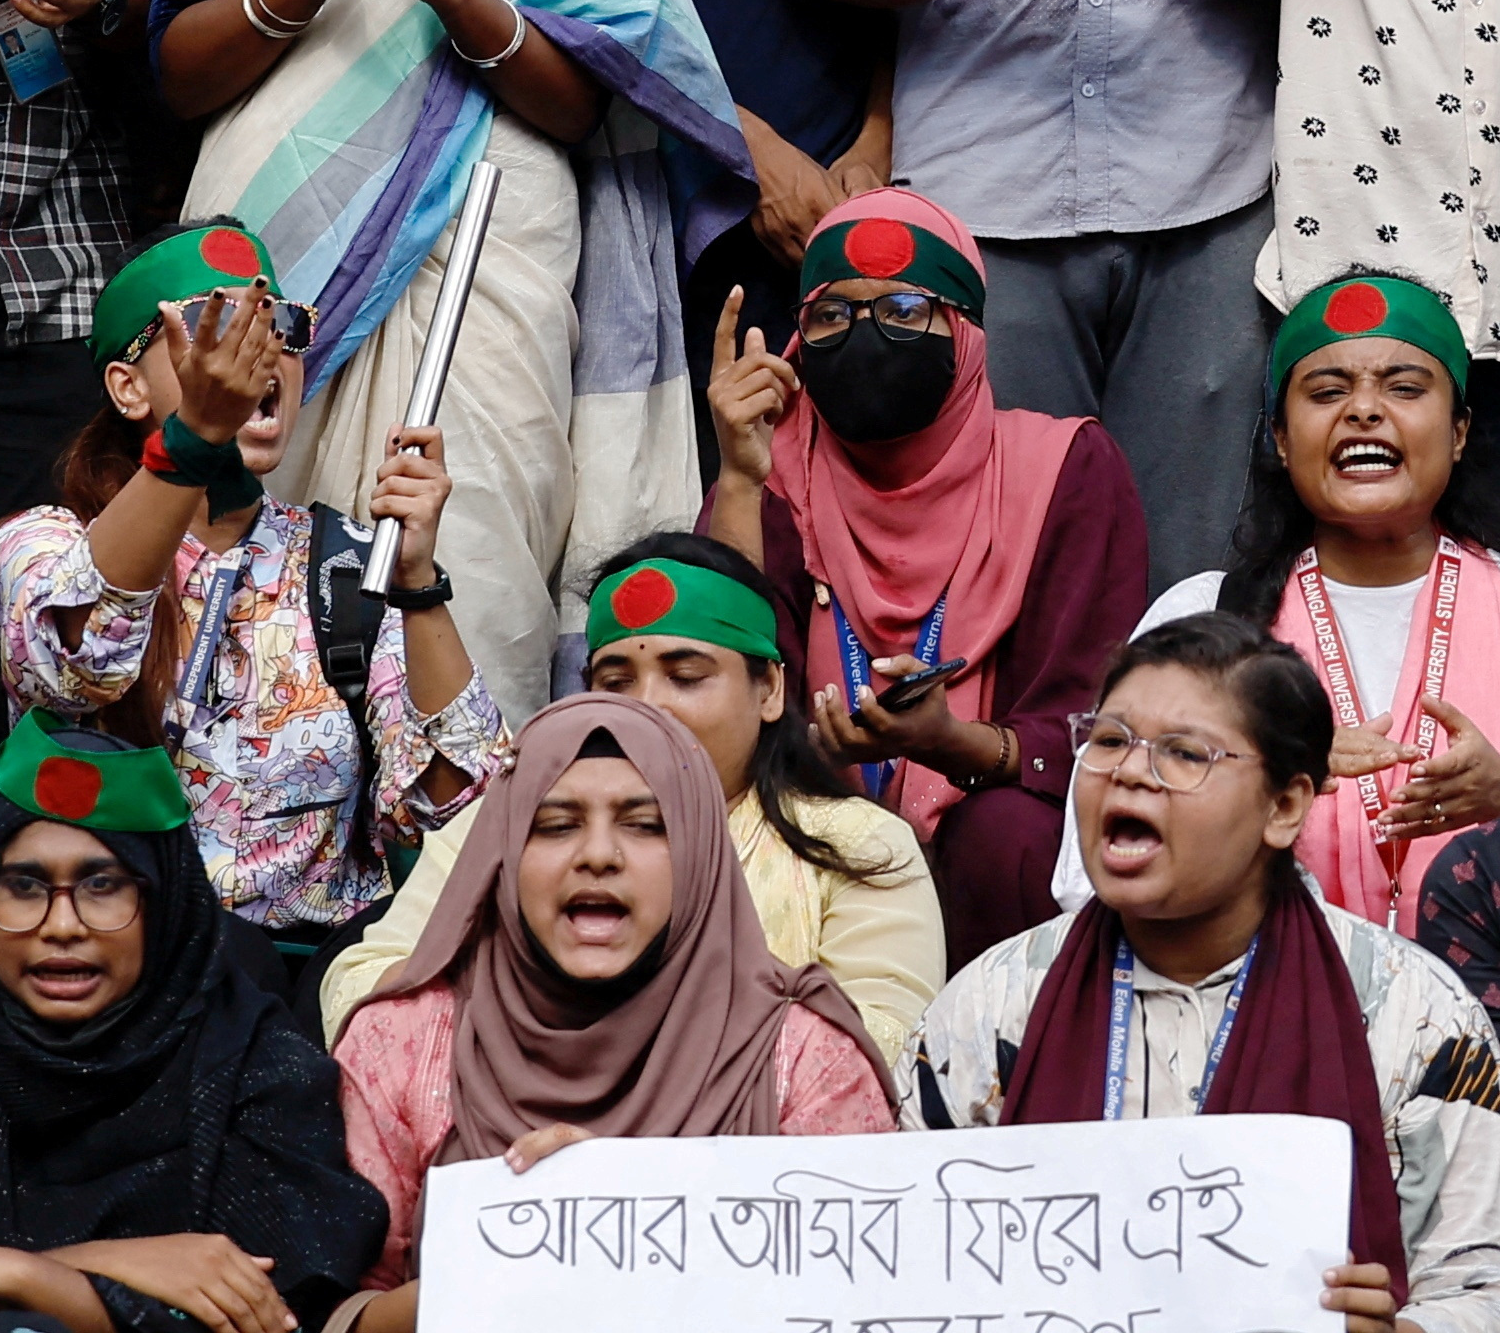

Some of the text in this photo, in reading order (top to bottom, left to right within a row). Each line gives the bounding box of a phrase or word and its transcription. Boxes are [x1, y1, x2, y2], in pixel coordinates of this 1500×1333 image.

[1300, 571, 1339, 665] BANGLADESH
[1434, 559, 1460, 620] STUDENT
[181, 576, 228, 700] INDEPENDENT UNIVERSITY
[1425, 626, 1451, 701] NIVERSITY
[1112, 987, 1129, 1022] Eden
[1108, 1025, 1127, 1073] Mohila
[478, 1153, 1268, 1286] আবার আসিব ফিরে এই
